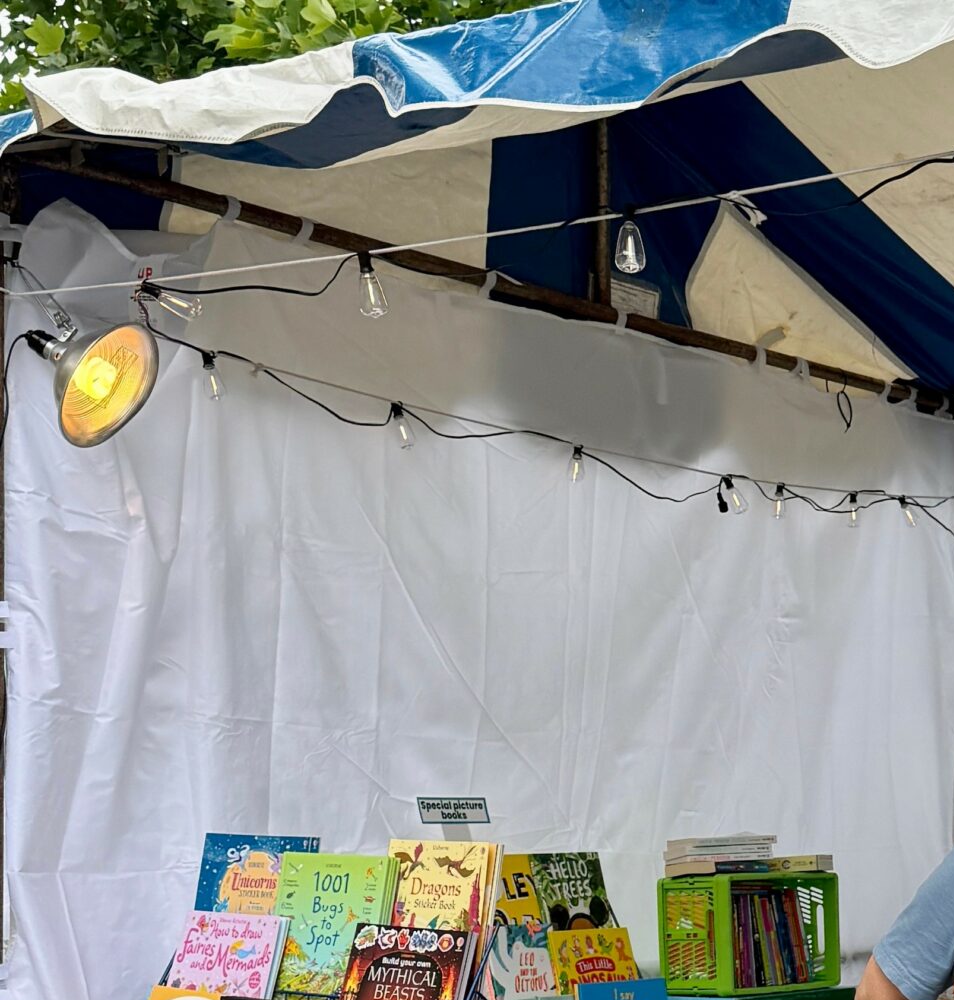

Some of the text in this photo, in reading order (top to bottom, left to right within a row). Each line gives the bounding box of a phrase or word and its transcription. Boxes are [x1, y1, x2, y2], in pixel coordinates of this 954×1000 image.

[420, 801, 483, 813] Special picture
[441, 810, 468, 820] books
[231, 871, 277, 891] Unicorns
[313, 871, 350, 894] 1001
[410, 877, 462, 902] Dragons
[552, 879, 592, 901] TREES
[312, 896, 344, 919] Bugs
[413, 898, 456, 910] Sticker Book
[210, 919, 263, 939] How to draw
[320, 917, 332, 931] to
[177, 928, 216, 963] Fairies
[306, 925, 340, 953] Spot
[190, 943, 272, 978] and Mermaids
[381, 956, 431, 968] Build your own
[519, 951, 535, 967] LEO
[577, 958, 614, 972] This Little
[367, 966, 437, 988] MYTHICAL
[514, 972, 549, 994] OCTOPUS
[613, 988, 619, 1000] I
